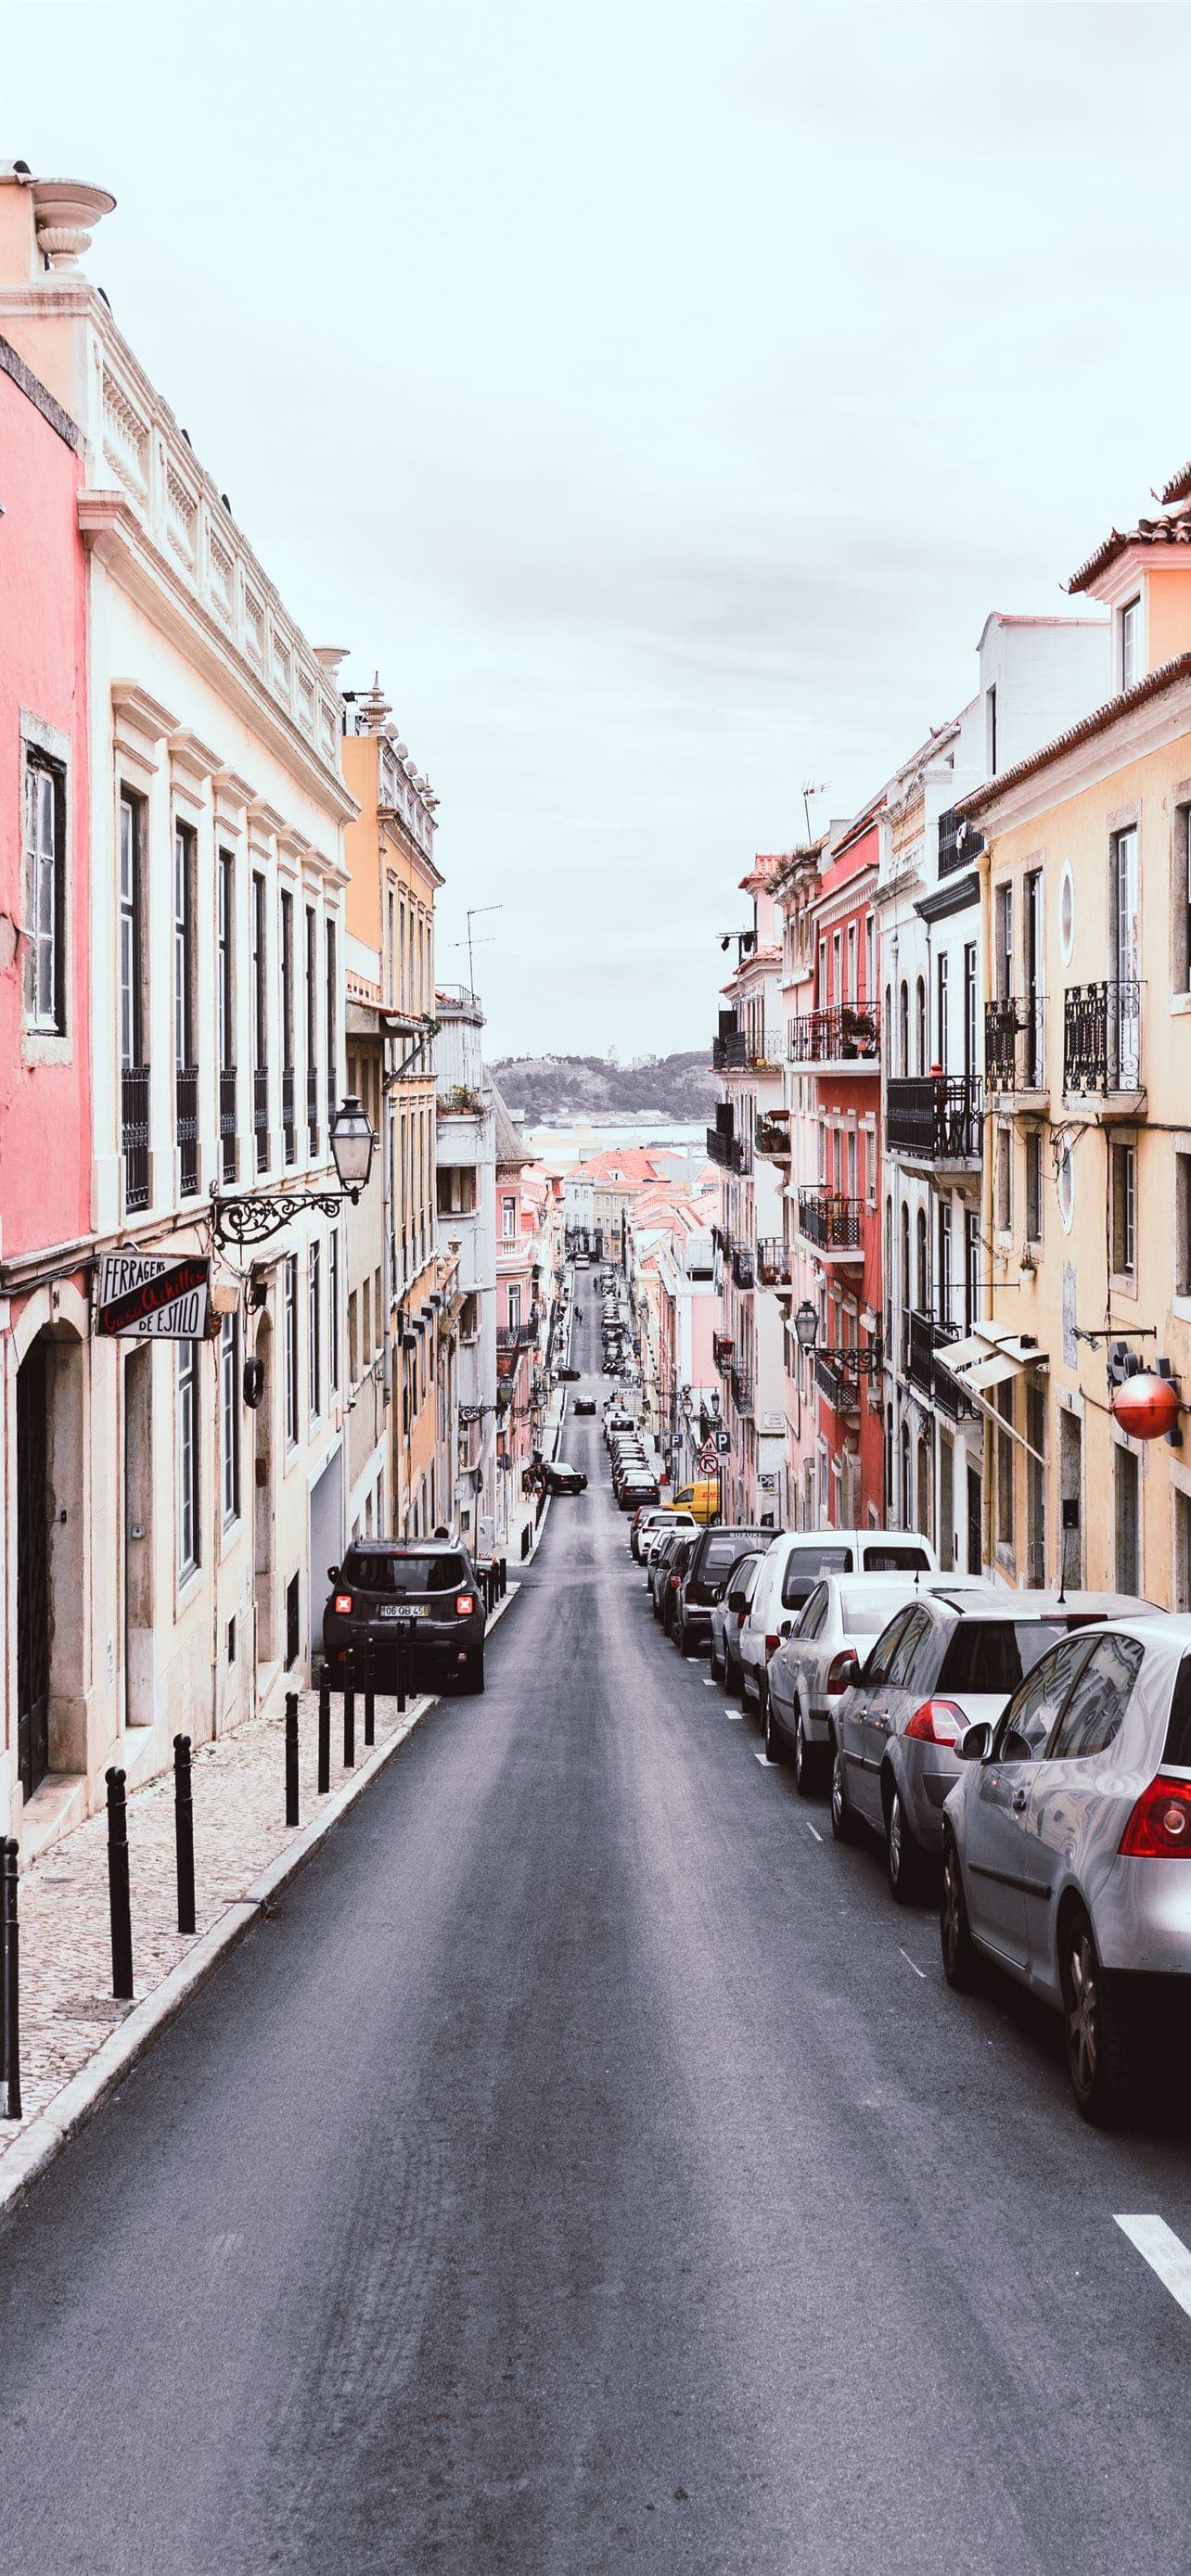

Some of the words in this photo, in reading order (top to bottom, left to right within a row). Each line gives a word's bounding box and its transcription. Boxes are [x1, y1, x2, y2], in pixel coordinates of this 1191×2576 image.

[104, 1258, 165, 1303] FERRAGENS
[139, 1315, 153, 1332] DE
[157, 1293, 199, 1333] ESTILO
[672, 1435, 680, 1447] P
[718, 1434, 728, 1450] P
